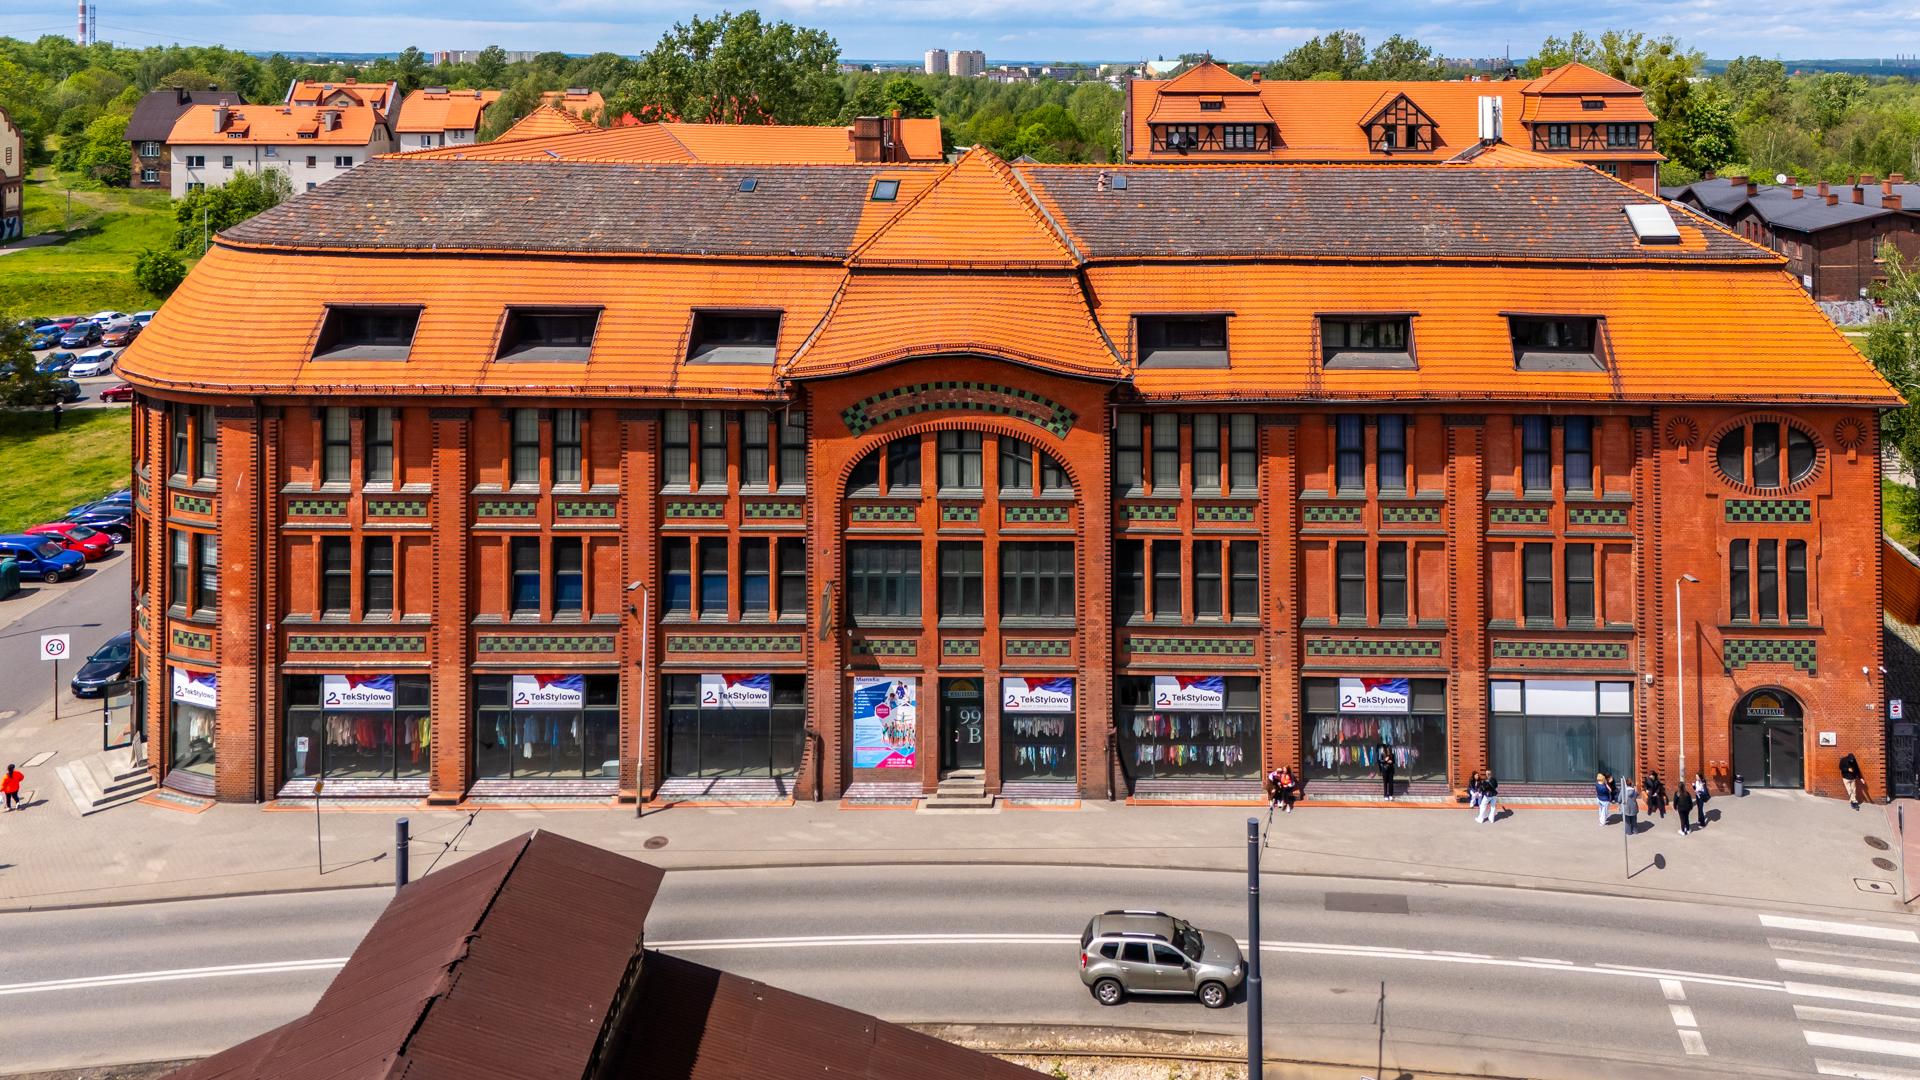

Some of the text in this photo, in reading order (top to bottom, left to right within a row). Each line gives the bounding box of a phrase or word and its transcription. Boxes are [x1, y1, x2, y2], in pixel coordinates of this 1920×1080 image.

[49, 642, 63, 652] 20
[341, 692, 392, 702] TekStylowo
[530, 692, 581, 702] TekStylowo
[718, 691, 768, 701] TekStylowo
[1019, 694, 1069, 705] TekStylowo
[1171, 693, 1221, 703] TekStylowo
[1356, 695, 1406, 706] TekStylowo
[960, 709, 982, 725] 99
[967, 727, 982, 744] B
